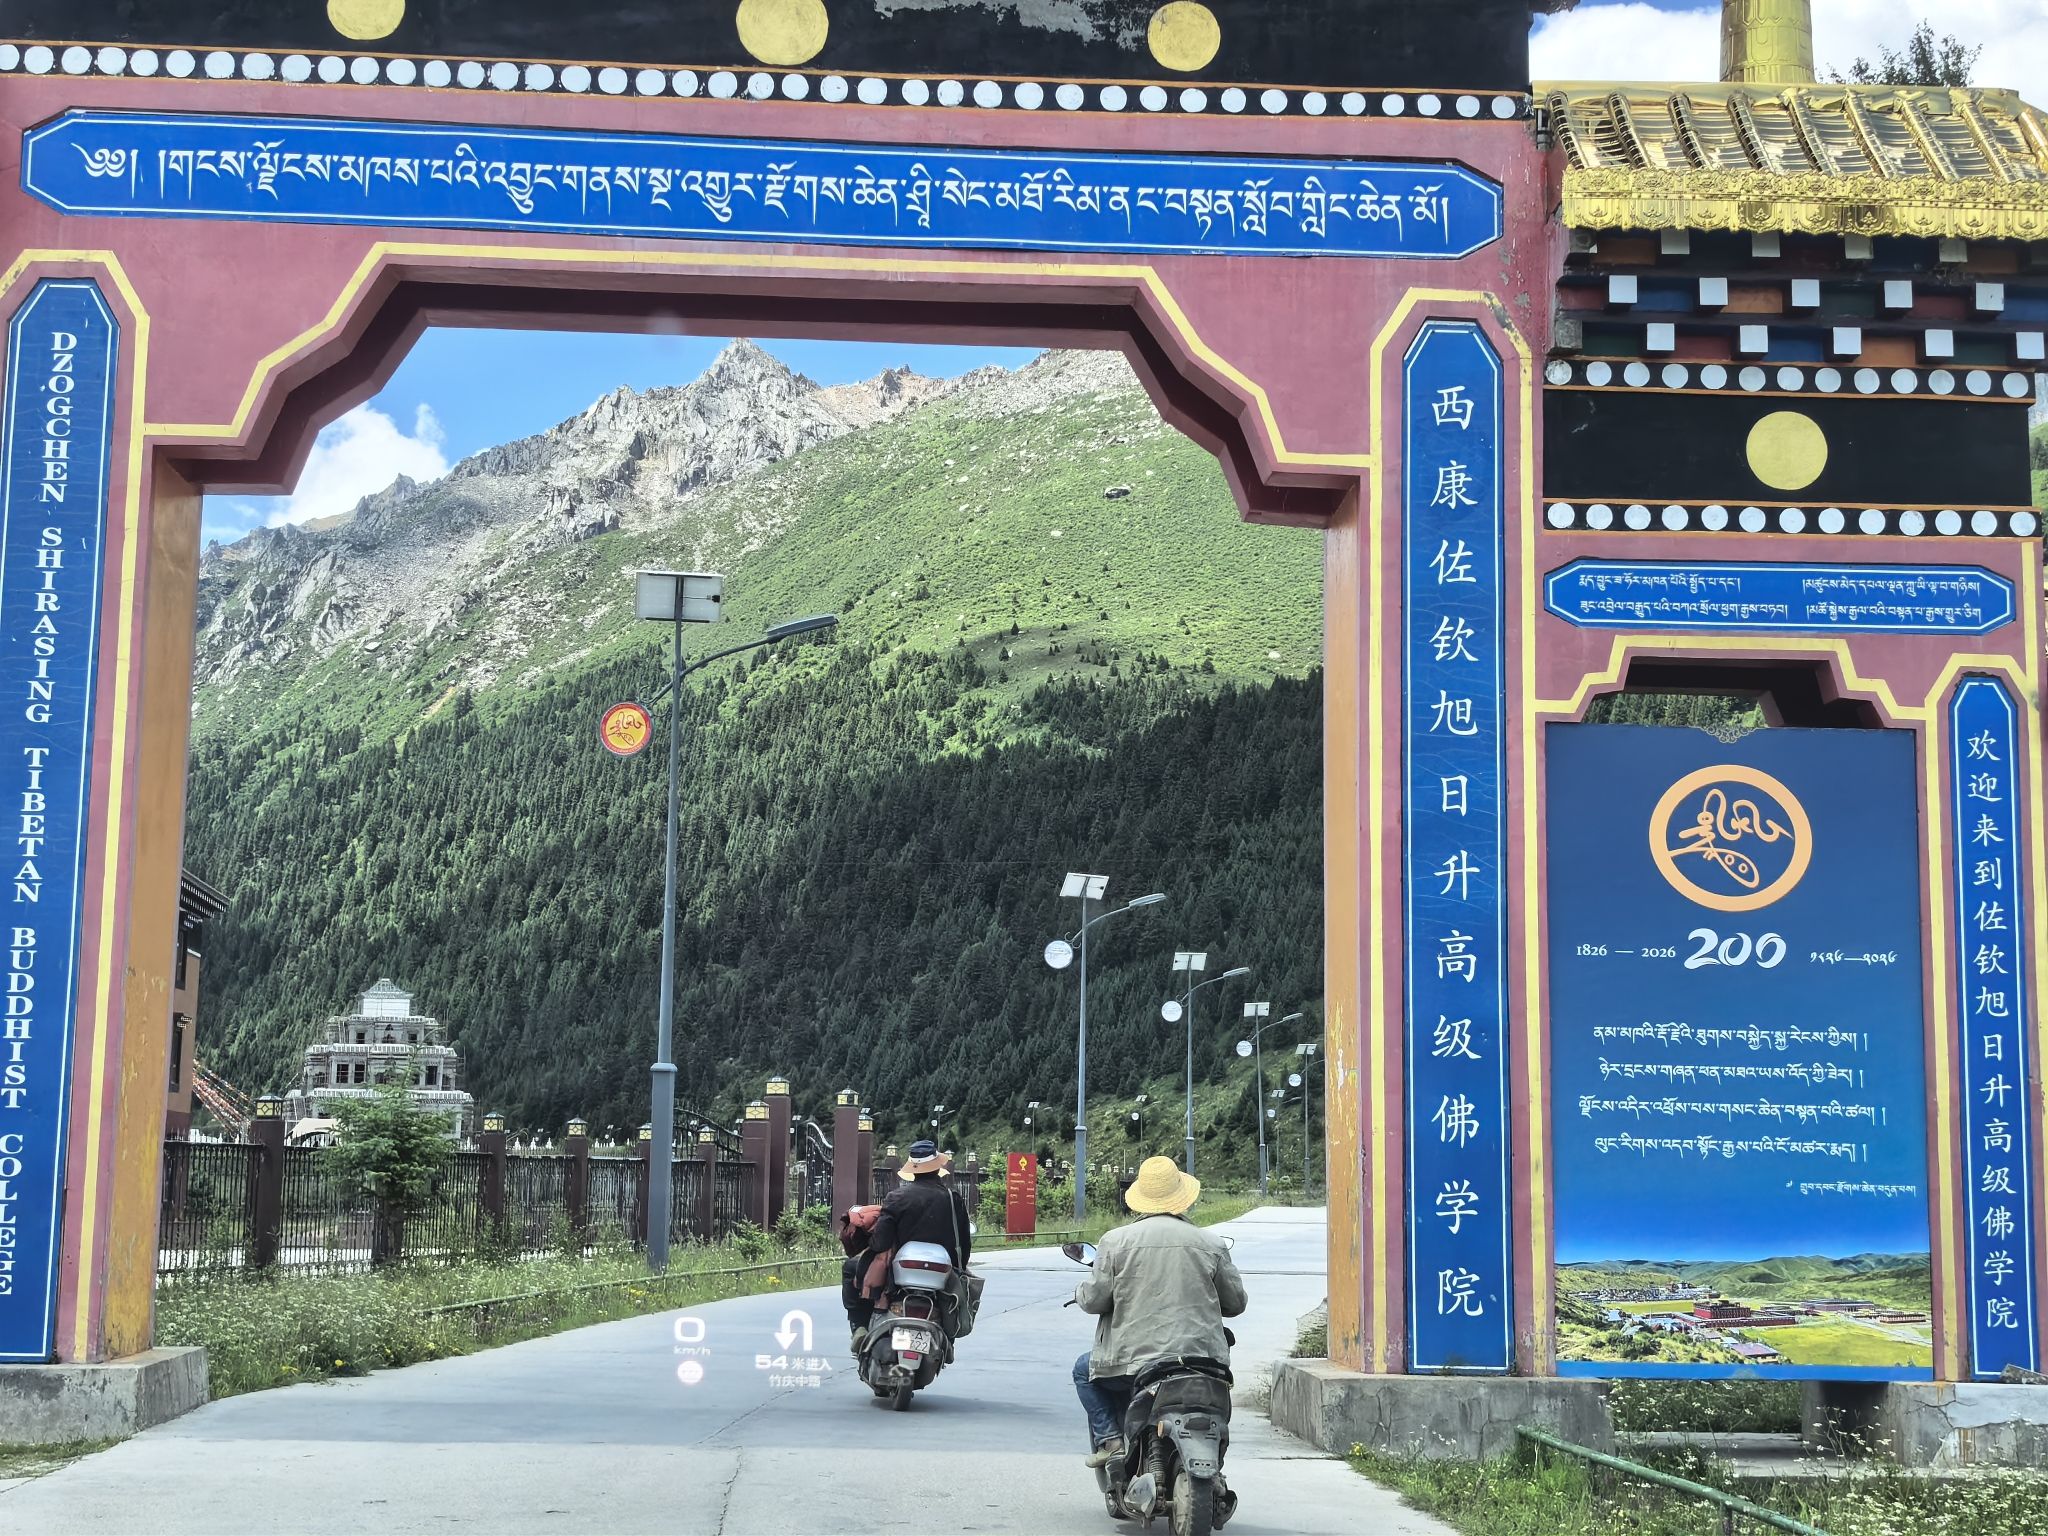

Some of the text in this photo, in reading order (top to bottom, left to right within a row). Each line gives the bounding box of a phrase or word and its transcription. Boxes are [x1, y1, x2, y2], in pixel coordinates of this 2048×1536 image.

[40, 331, 77, 503] DZOGCHEN
[26, 527, 64, 724] SHIRASING
[13, 747, 49, 903] TIBETAN
[1429, 385, 1483, 1317] 西康佐钦旭日升高级佛学院
[1, 927, 36, 1108] BUDDHIST
[1576, 943, 1608, 957] 1826
[1641, 946, 1676, 958] 2026
[1683, 928, 1787, 970] 200
[1966, 728, 2018, 1329] 欢迎来到佐钦旭日升高级佛学院
[673, 1346, 711, 1356] km/h
[674, 1317, 706, 1343] 0
[755, 1354, 833, 1371] 54 米进入
